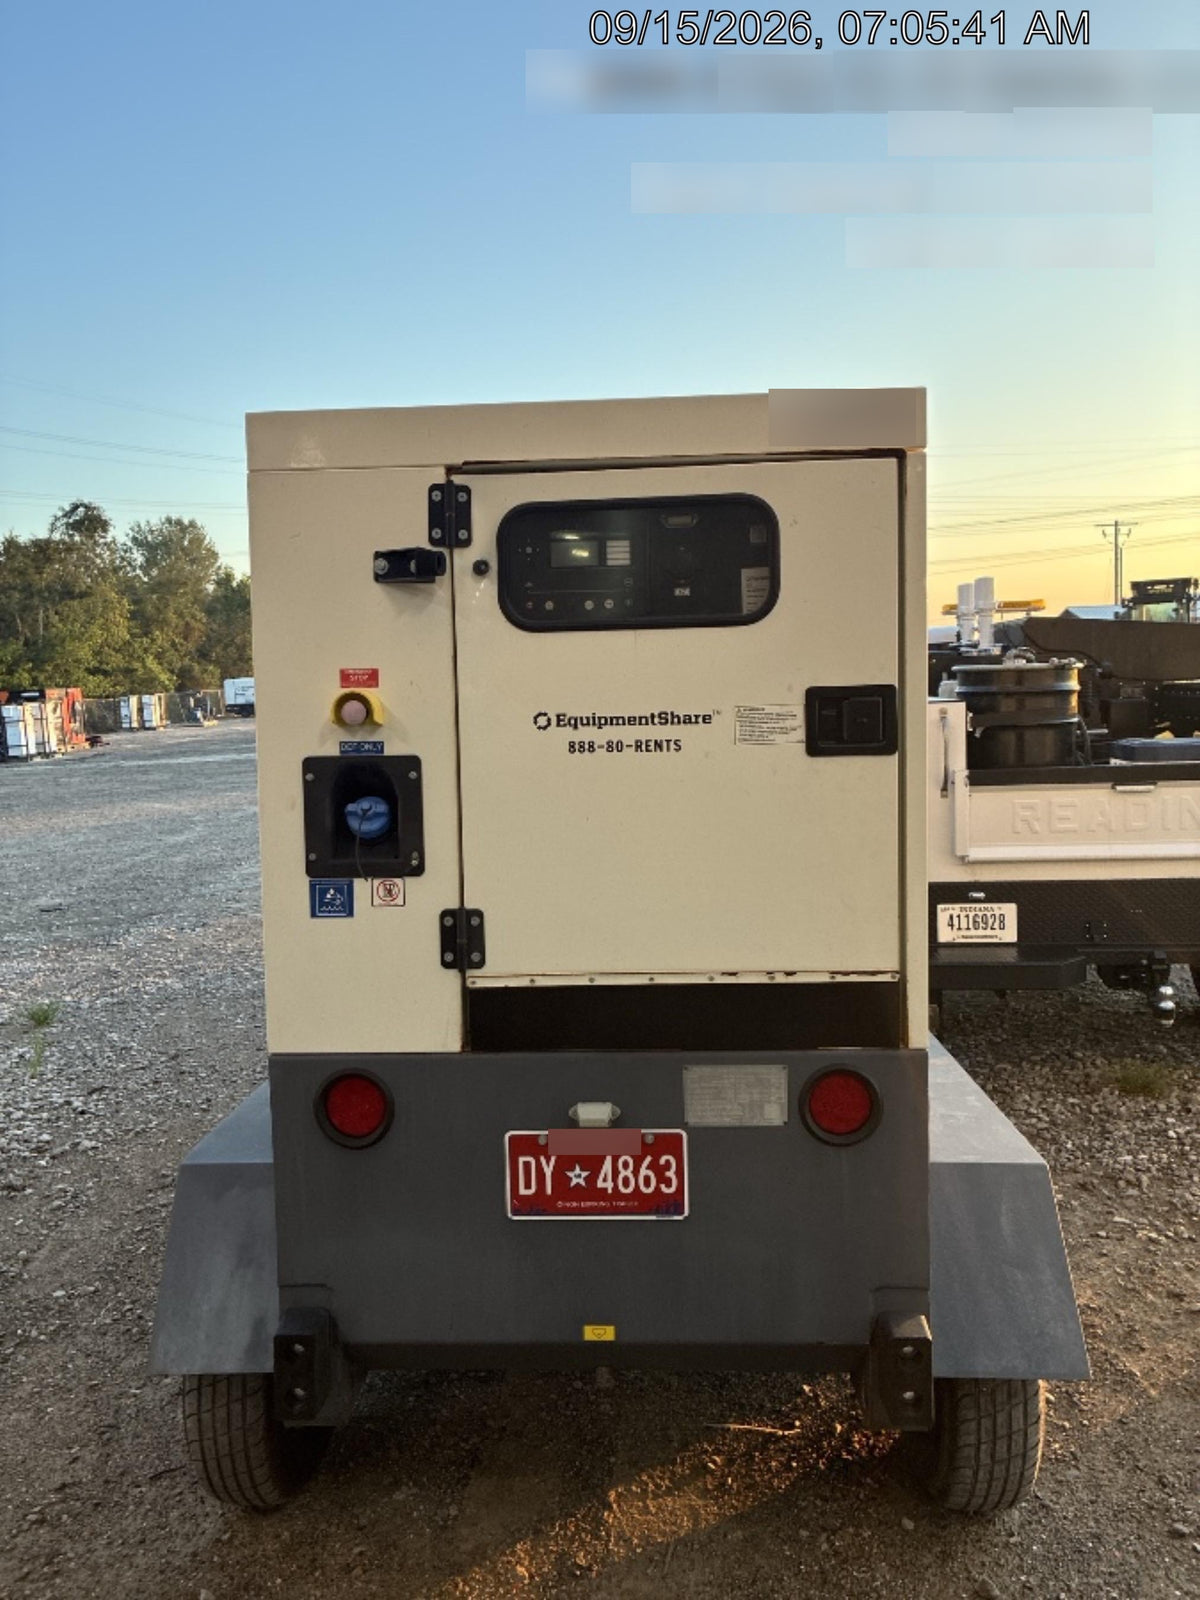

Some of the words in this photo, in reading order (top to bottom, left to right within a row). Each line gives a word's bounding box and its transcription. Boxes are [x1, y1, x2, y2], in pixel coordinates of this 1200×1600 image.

[555, 711, 712, 730] EquipmentShare
[568, 739, 682, 754] 888-80-RENTS
[947, 913, 1006, 932] 4116928
[518, 1155, 557, 1196] DY
[596, 1154, 679, 1194] 4863
